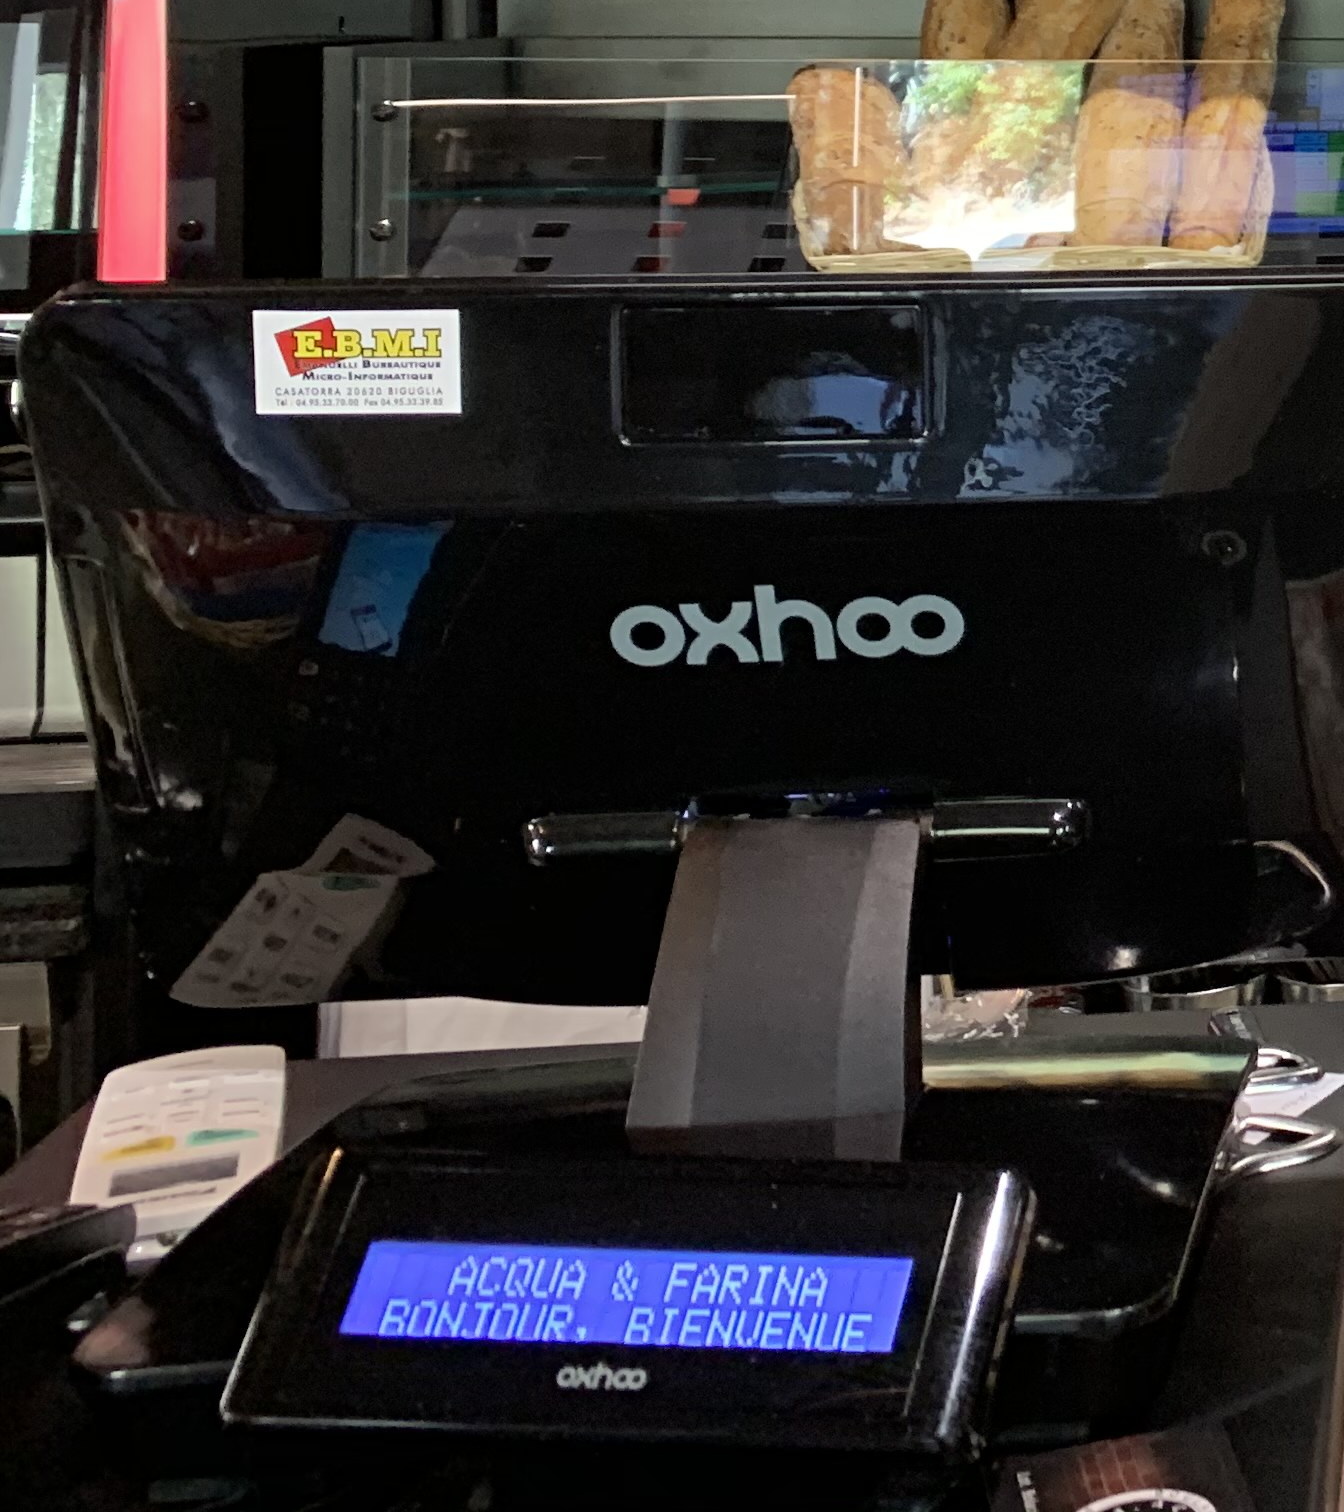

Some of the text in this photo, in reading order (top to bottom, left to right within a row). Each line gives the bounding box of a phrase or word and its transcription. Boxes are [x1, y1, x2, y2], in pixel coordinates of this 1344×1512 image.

[292, 328, 442, 359] E.B.M.I
[302, 371, 433, 381] MICRO-INFORMATIQUE
[609, 584, 966, 667] oxhoo
[447, 1255, 829, 1308] ACQUA & FARINA
[556, 1361, 648, 1391] oxhoo
